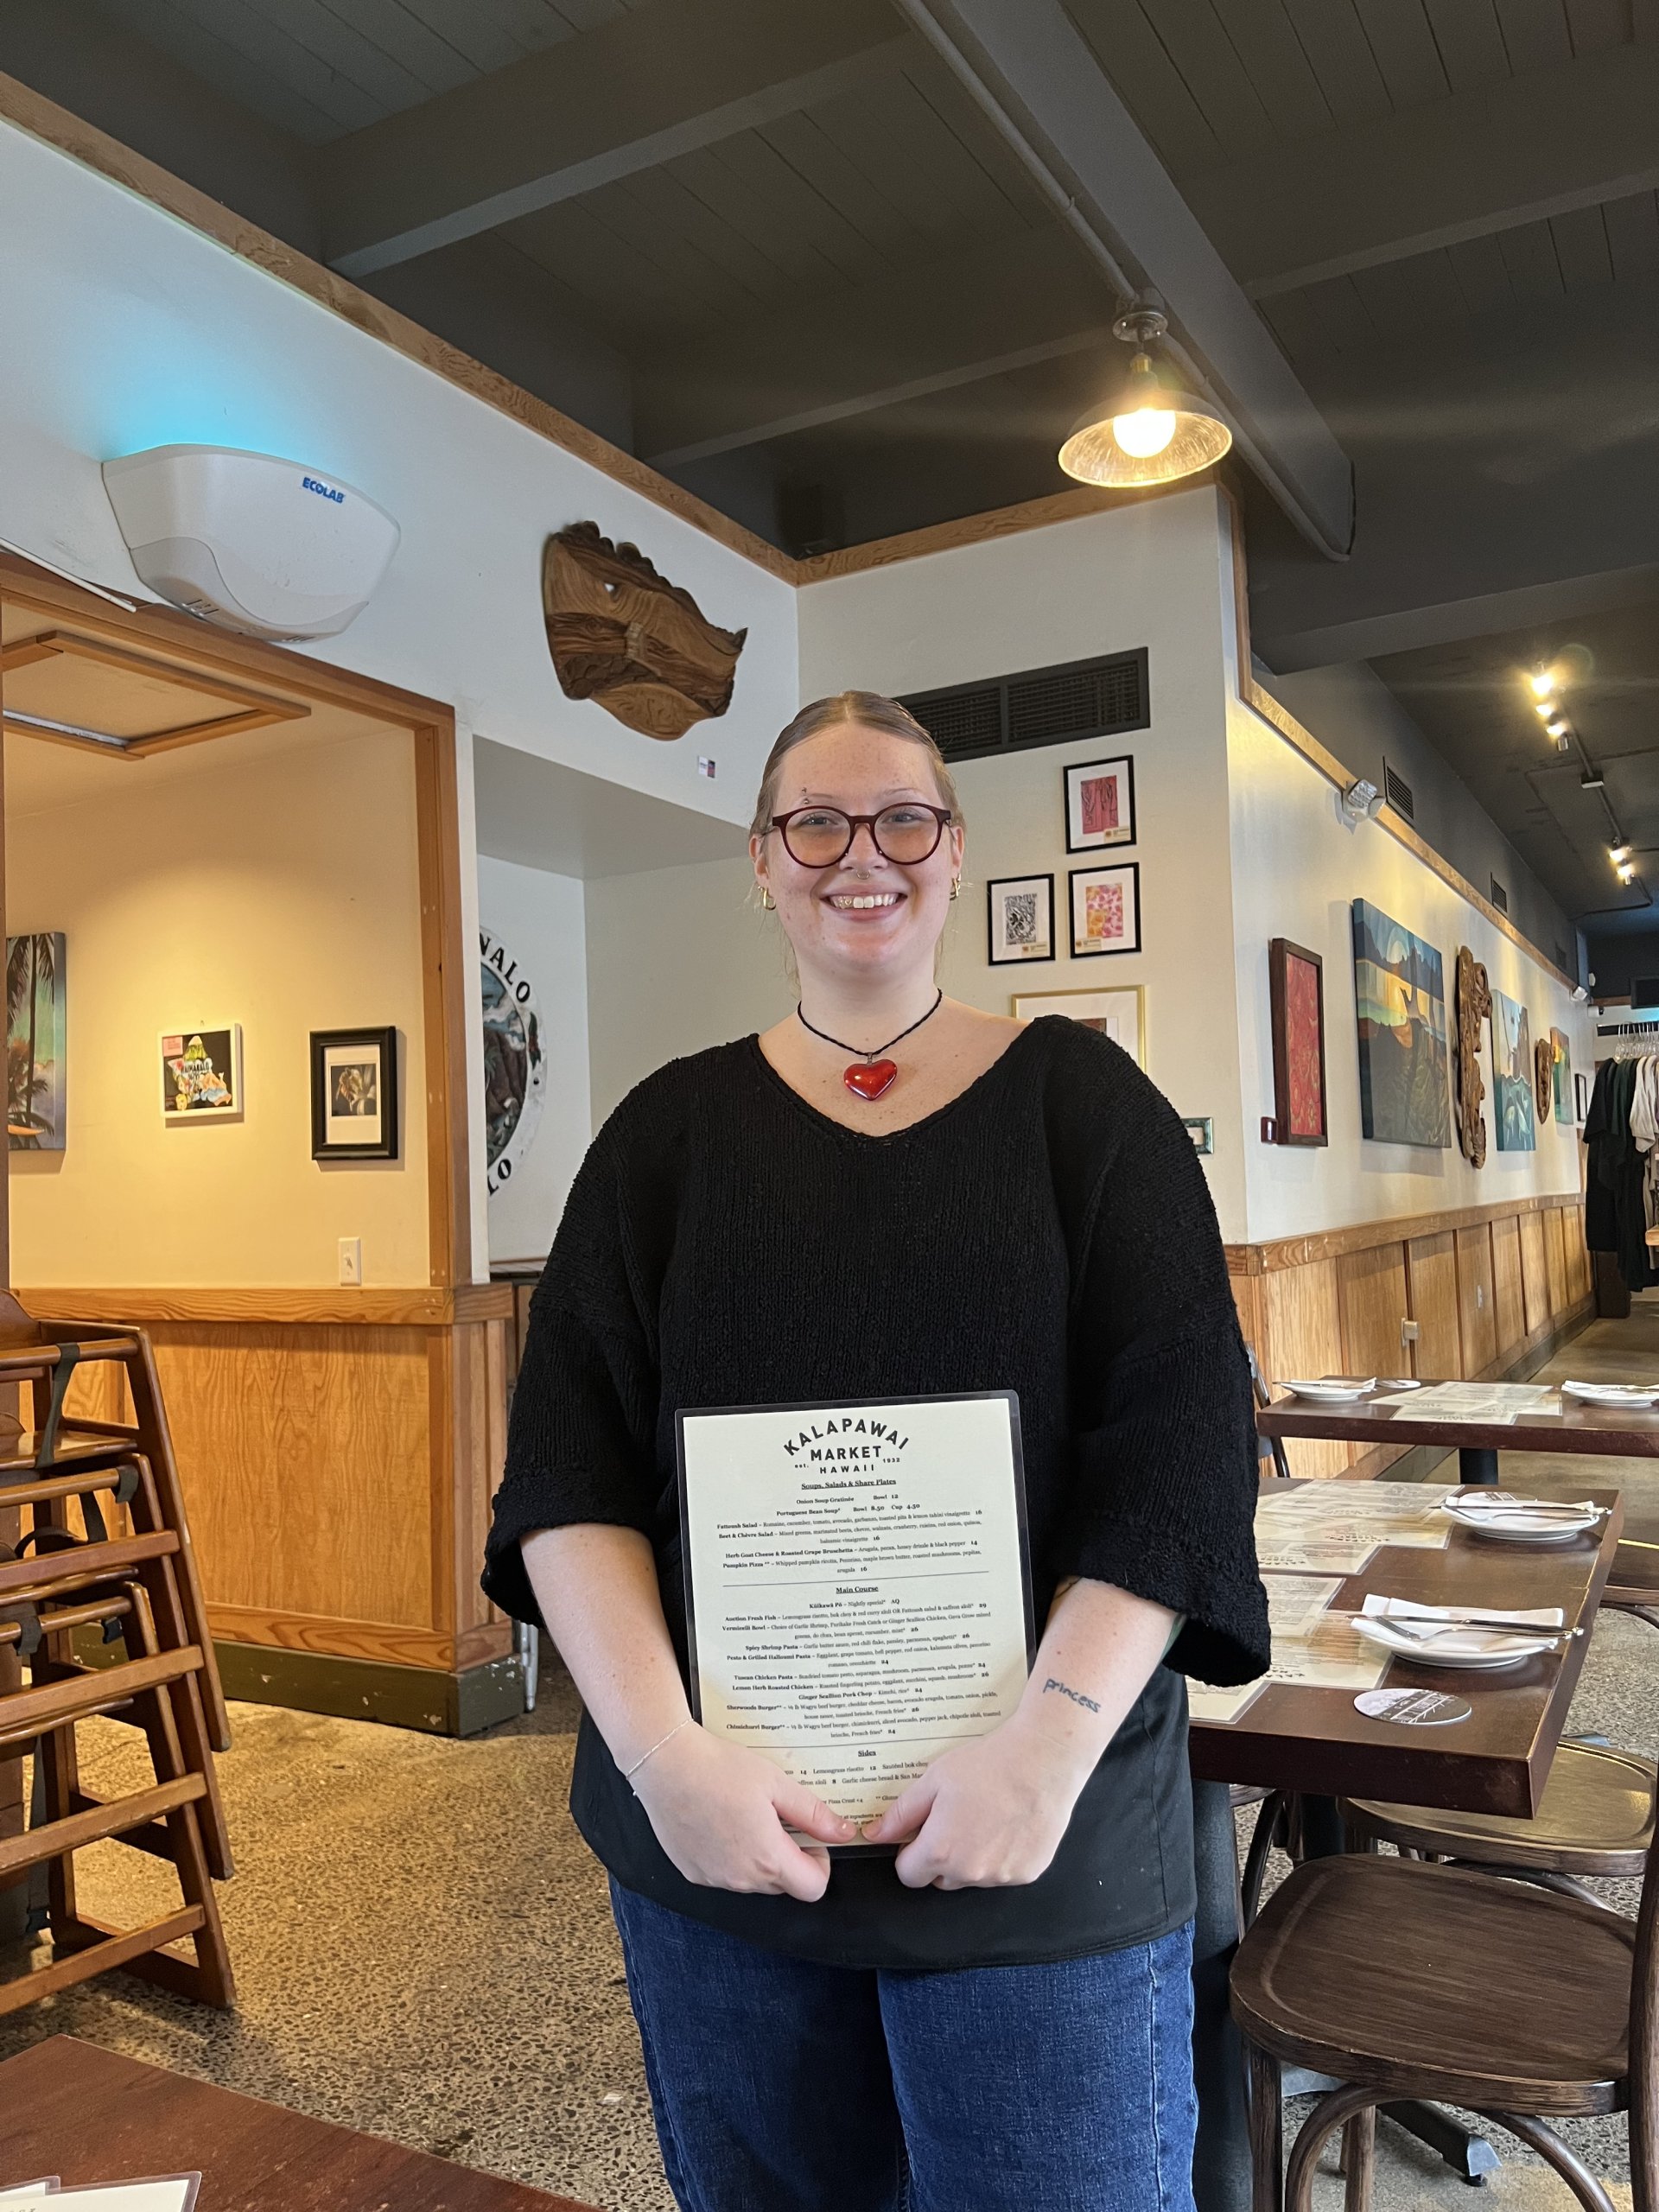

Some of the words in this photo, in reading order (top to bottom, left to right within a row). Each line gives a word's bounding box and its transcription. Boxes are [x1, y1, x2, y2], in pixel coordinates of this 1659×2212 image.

[302, 477, 345, 504] ECOLAB
[480, 933, 531, 1003] NALO
[784, 1418, 909, 1456] KALAPAWAI
[810, 1446, 881, 1461] MARKET
[820, 1464, 874, 1474] HAWAII
